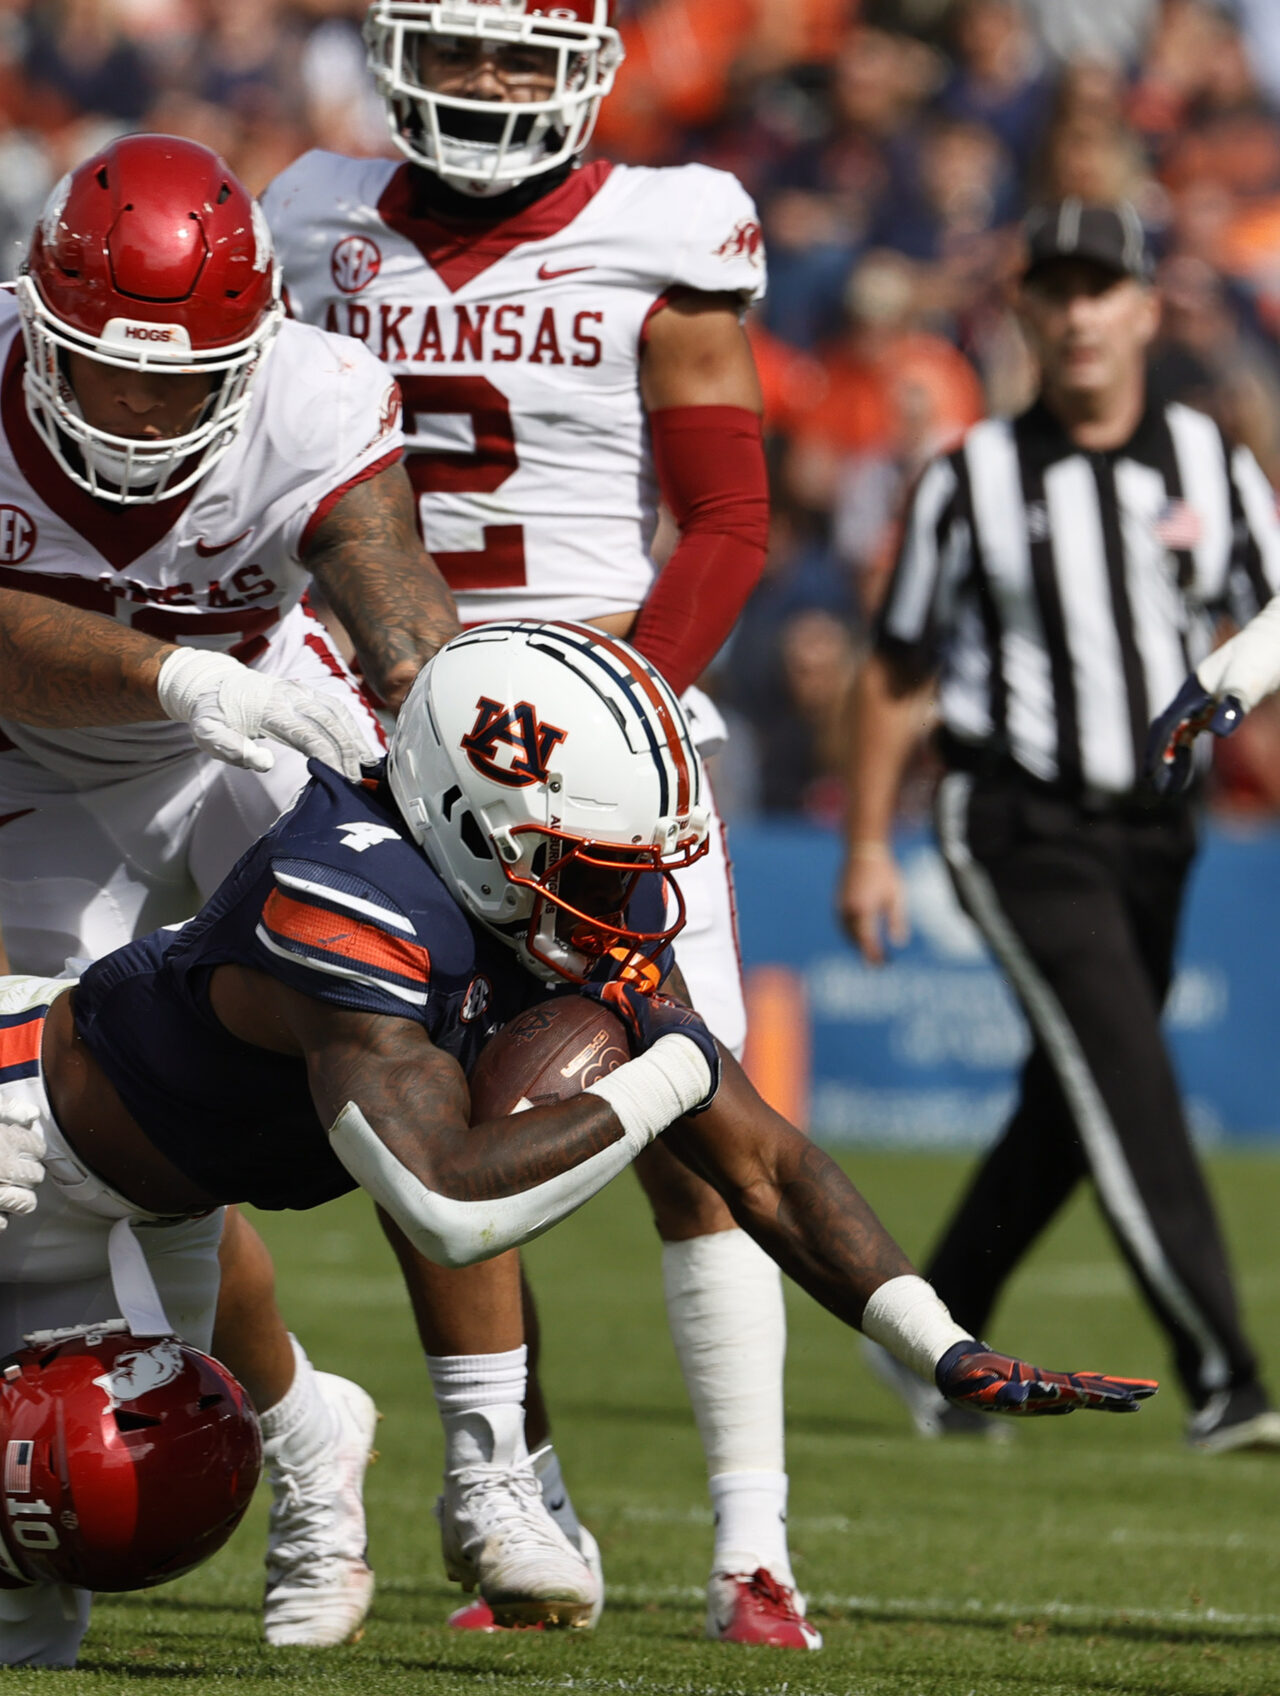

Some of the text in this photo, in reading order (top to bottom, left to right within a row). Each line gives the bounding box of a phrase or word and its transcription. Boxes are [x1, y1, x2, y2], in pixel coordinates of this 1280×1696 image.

[125, 326, 170, 342] HOGS
[392, 374, 528, 590] 2
[335, 822, 402, 852] 4
[6, 1498, 61, 1550] 10
